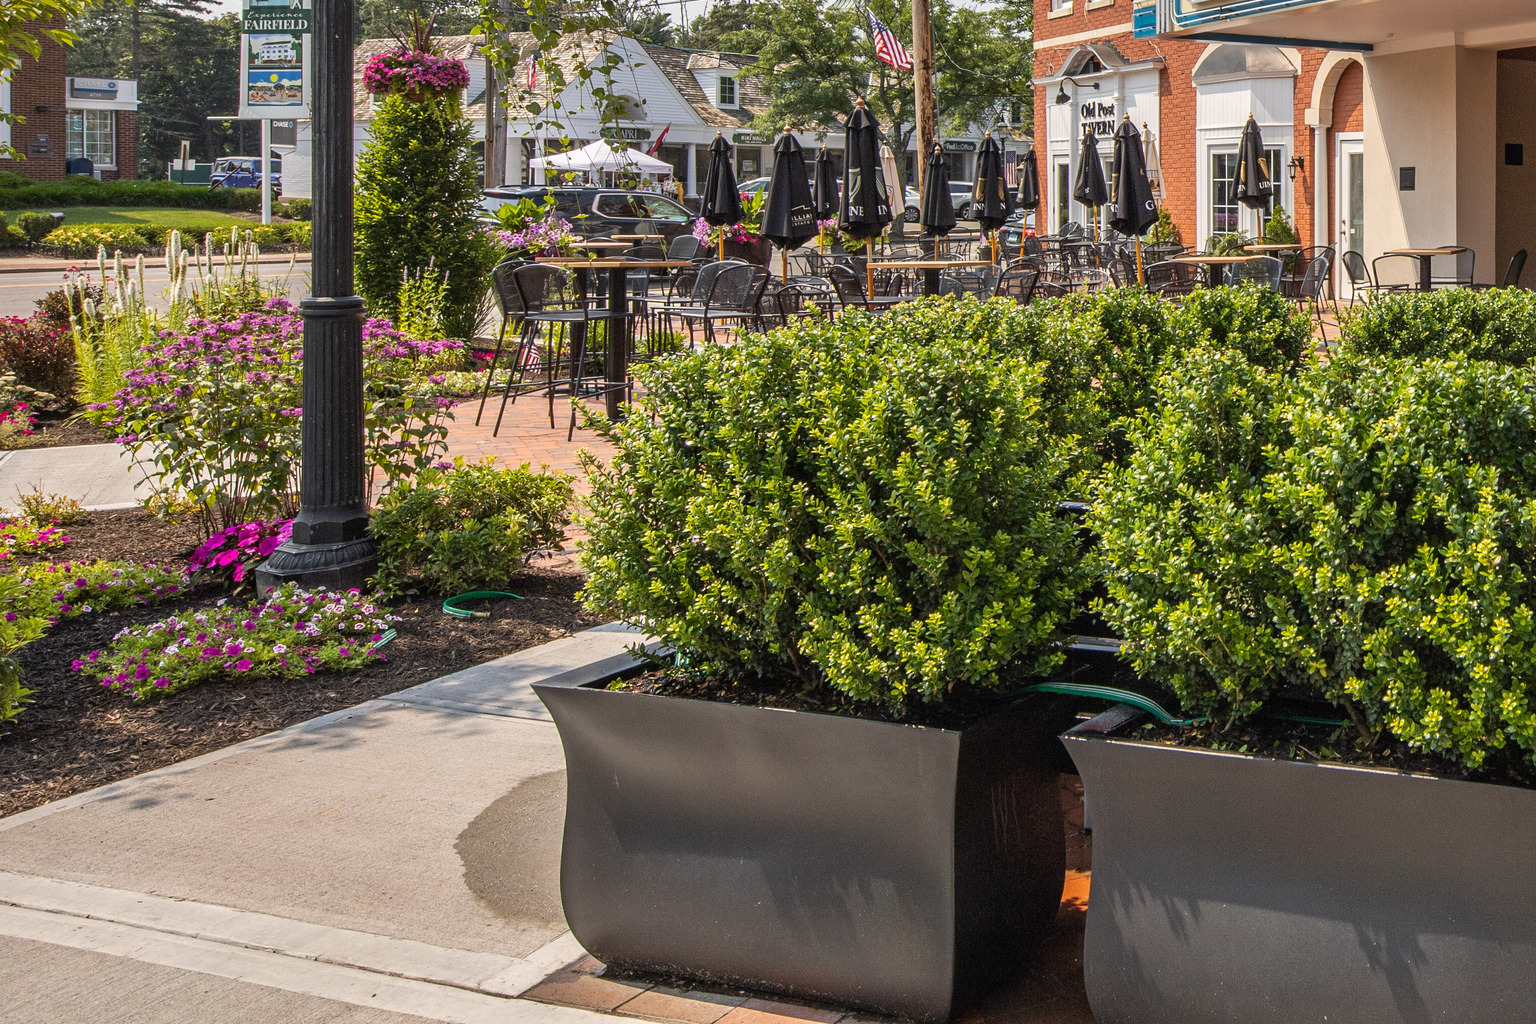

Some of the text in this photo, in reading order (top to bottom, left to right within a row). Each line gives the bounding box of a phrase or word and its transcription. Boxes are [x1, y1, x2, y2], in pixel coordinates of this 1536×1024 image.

[247, 11, 303, 20] Experience
[244, 19, 308, 30] FAIRFIELD
[1081, 101, 1115, 118] Old Post
[1081, 120, 1115, 136] TAVERN
